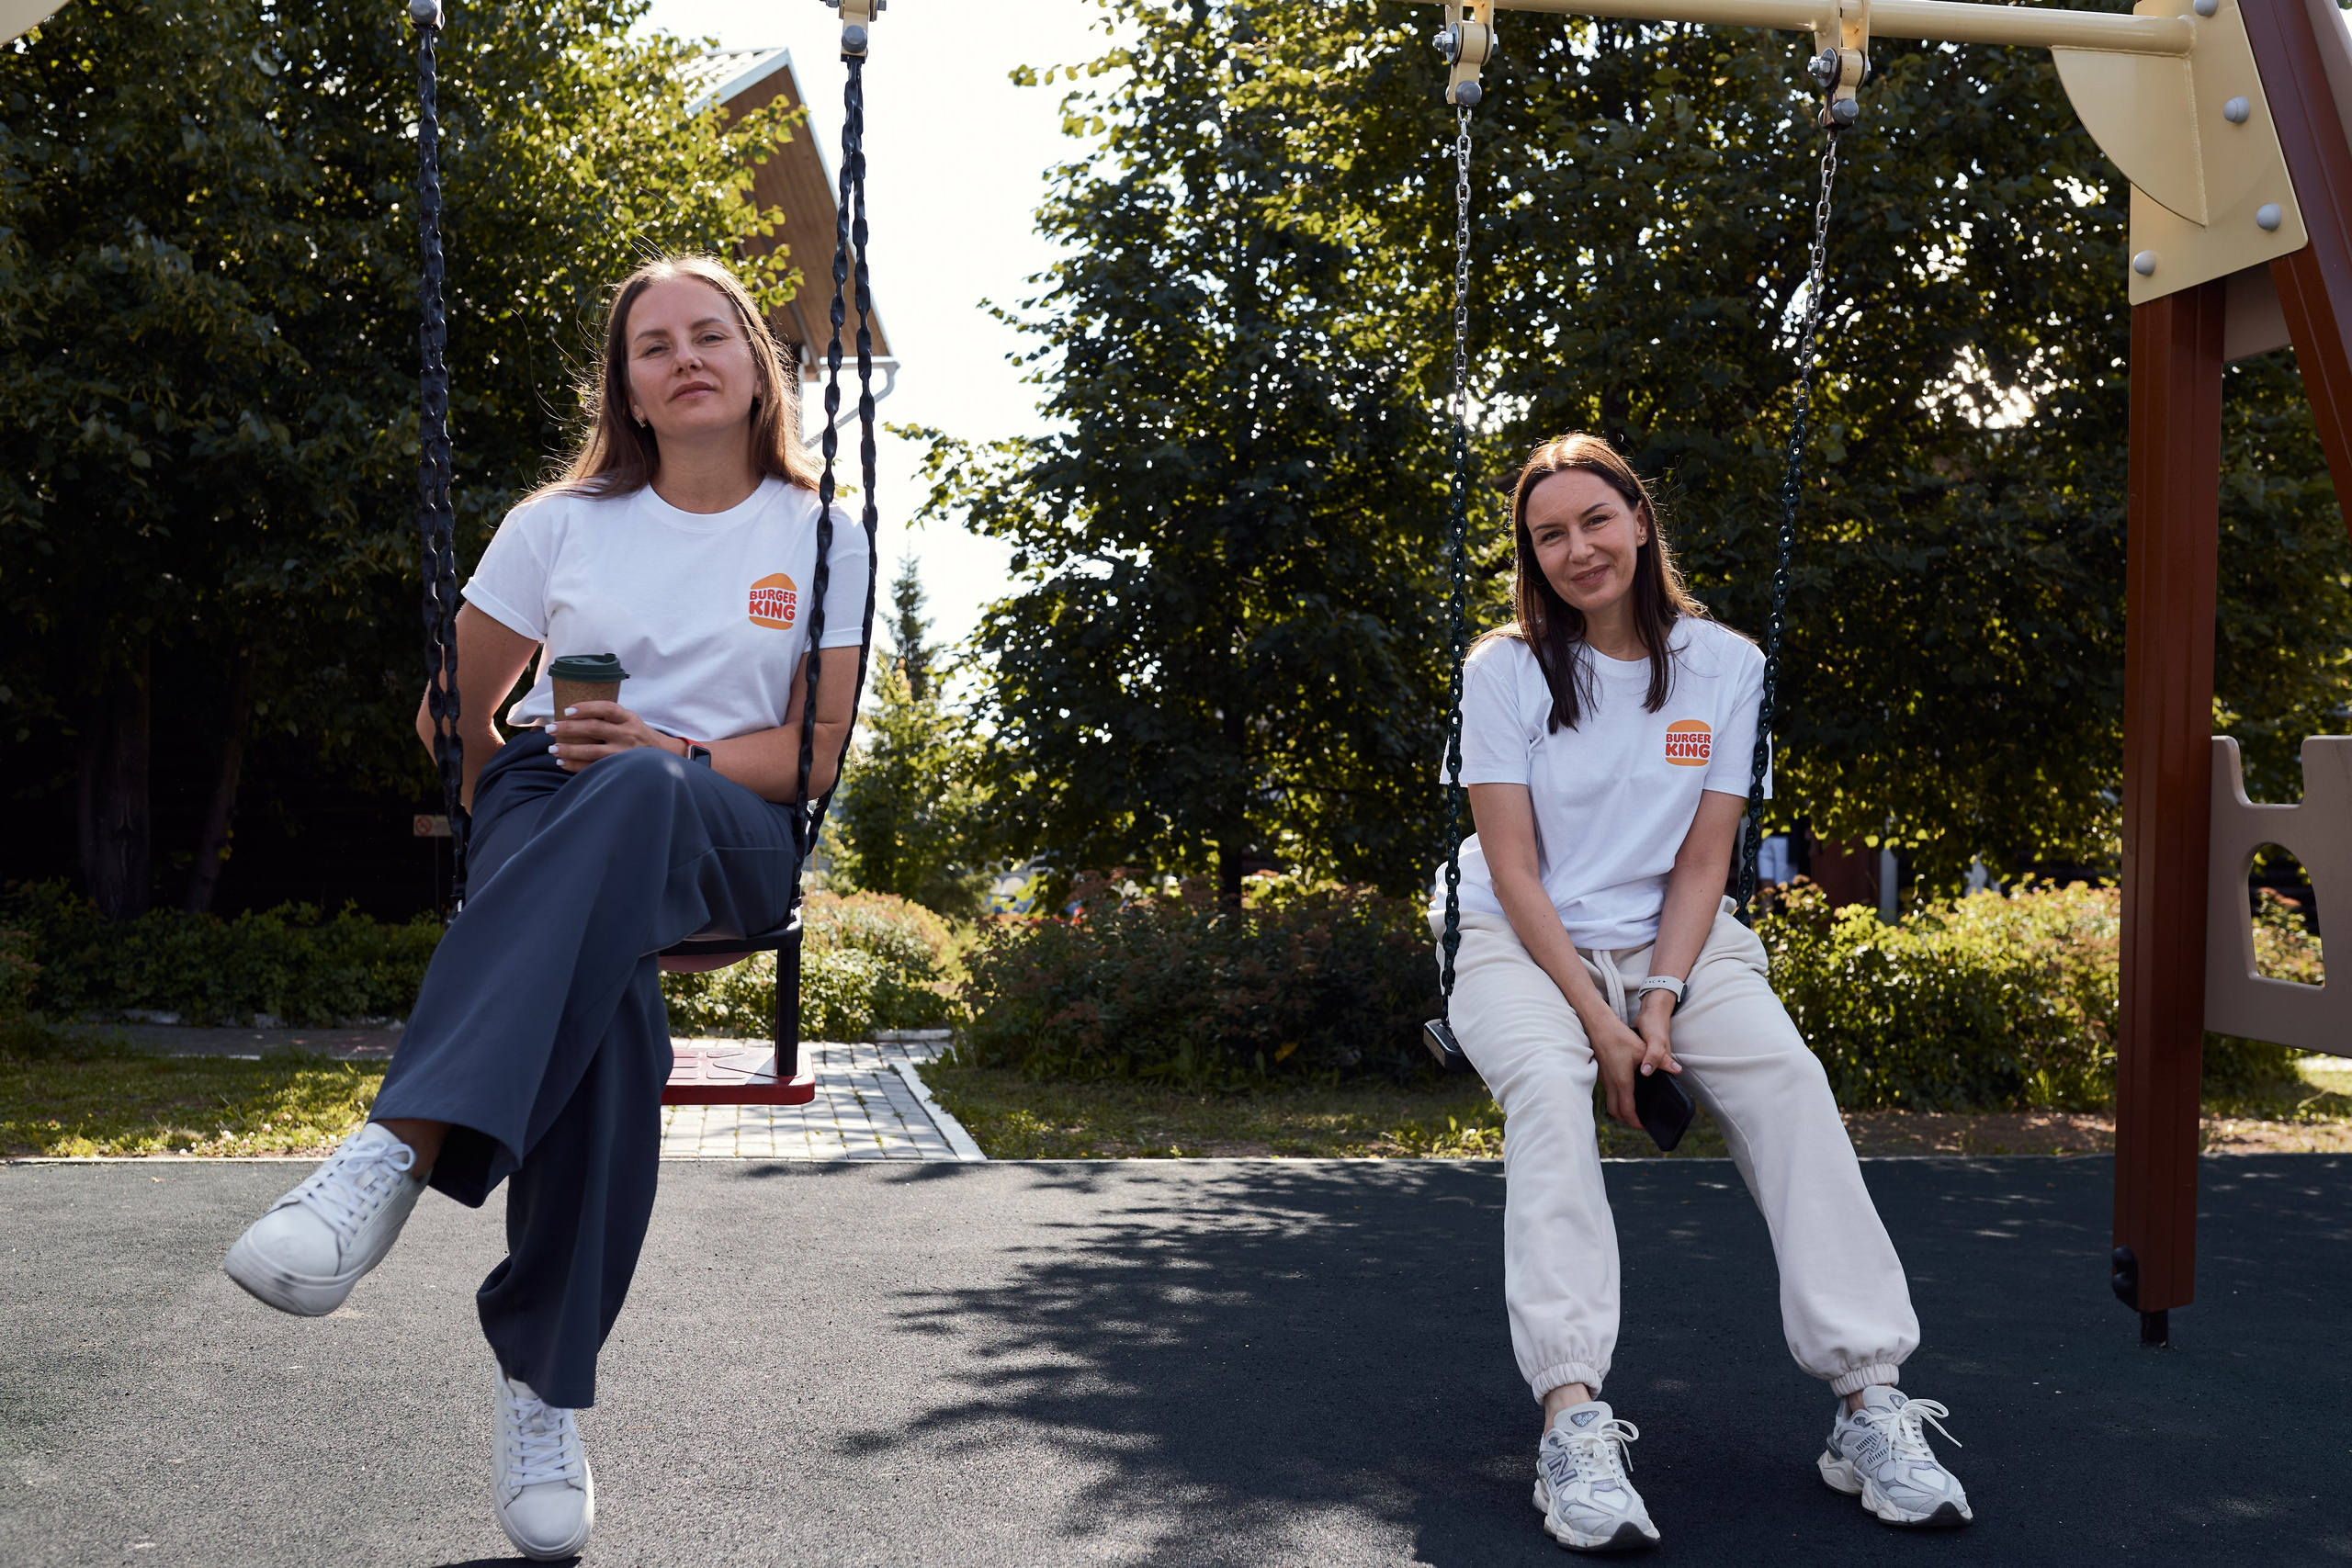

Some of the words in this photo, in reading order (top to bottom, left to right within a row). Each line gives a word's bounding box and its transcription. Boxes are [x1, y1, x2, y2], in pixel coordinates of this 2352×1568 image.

[750, 590, 797, 604] BURGER
[749, 600, 796, 621] KING
[1666, 733, 1712, 744] BURGER
[1665, 743, 1711, 758] KING
